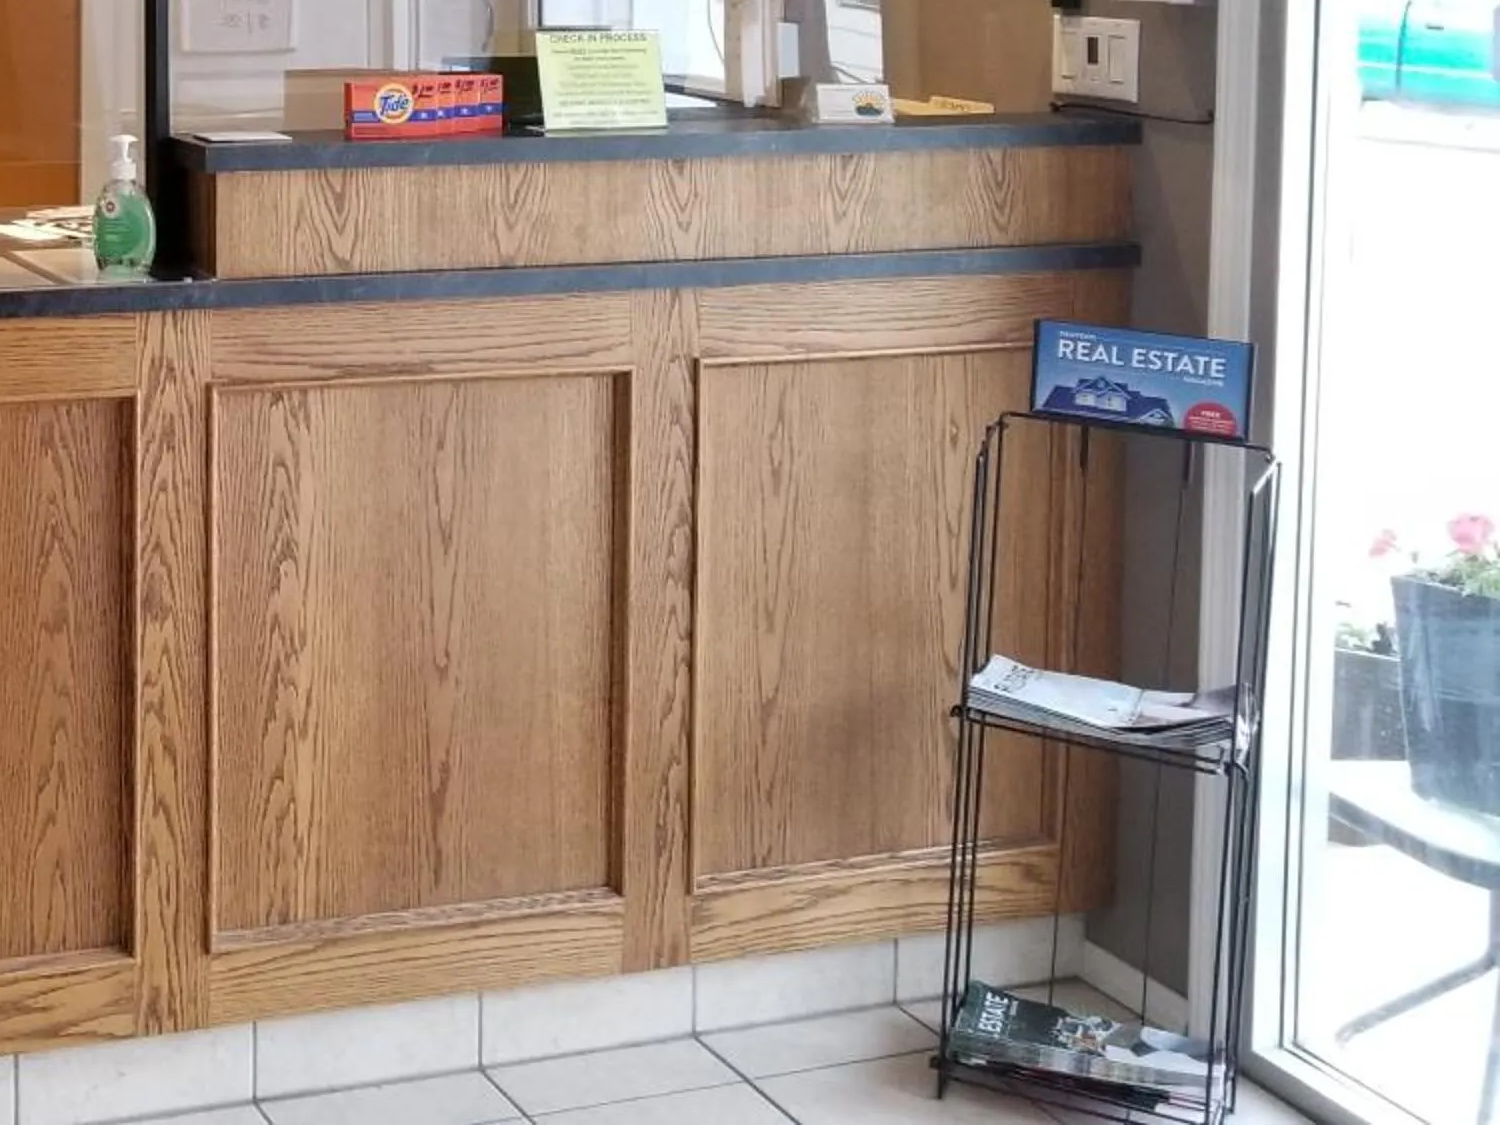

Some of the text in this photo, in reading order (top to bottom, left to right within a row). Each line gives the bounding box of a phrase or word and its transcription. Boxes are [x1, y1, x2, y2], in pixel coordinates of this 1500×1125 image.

[600, 32, 647, 43] PROCESS
[378, 93, 410, 116] Tide
[1058, 339, 1228, 379] REAL ESTATE
[978, 991, 1009, 1032] ESTATE
